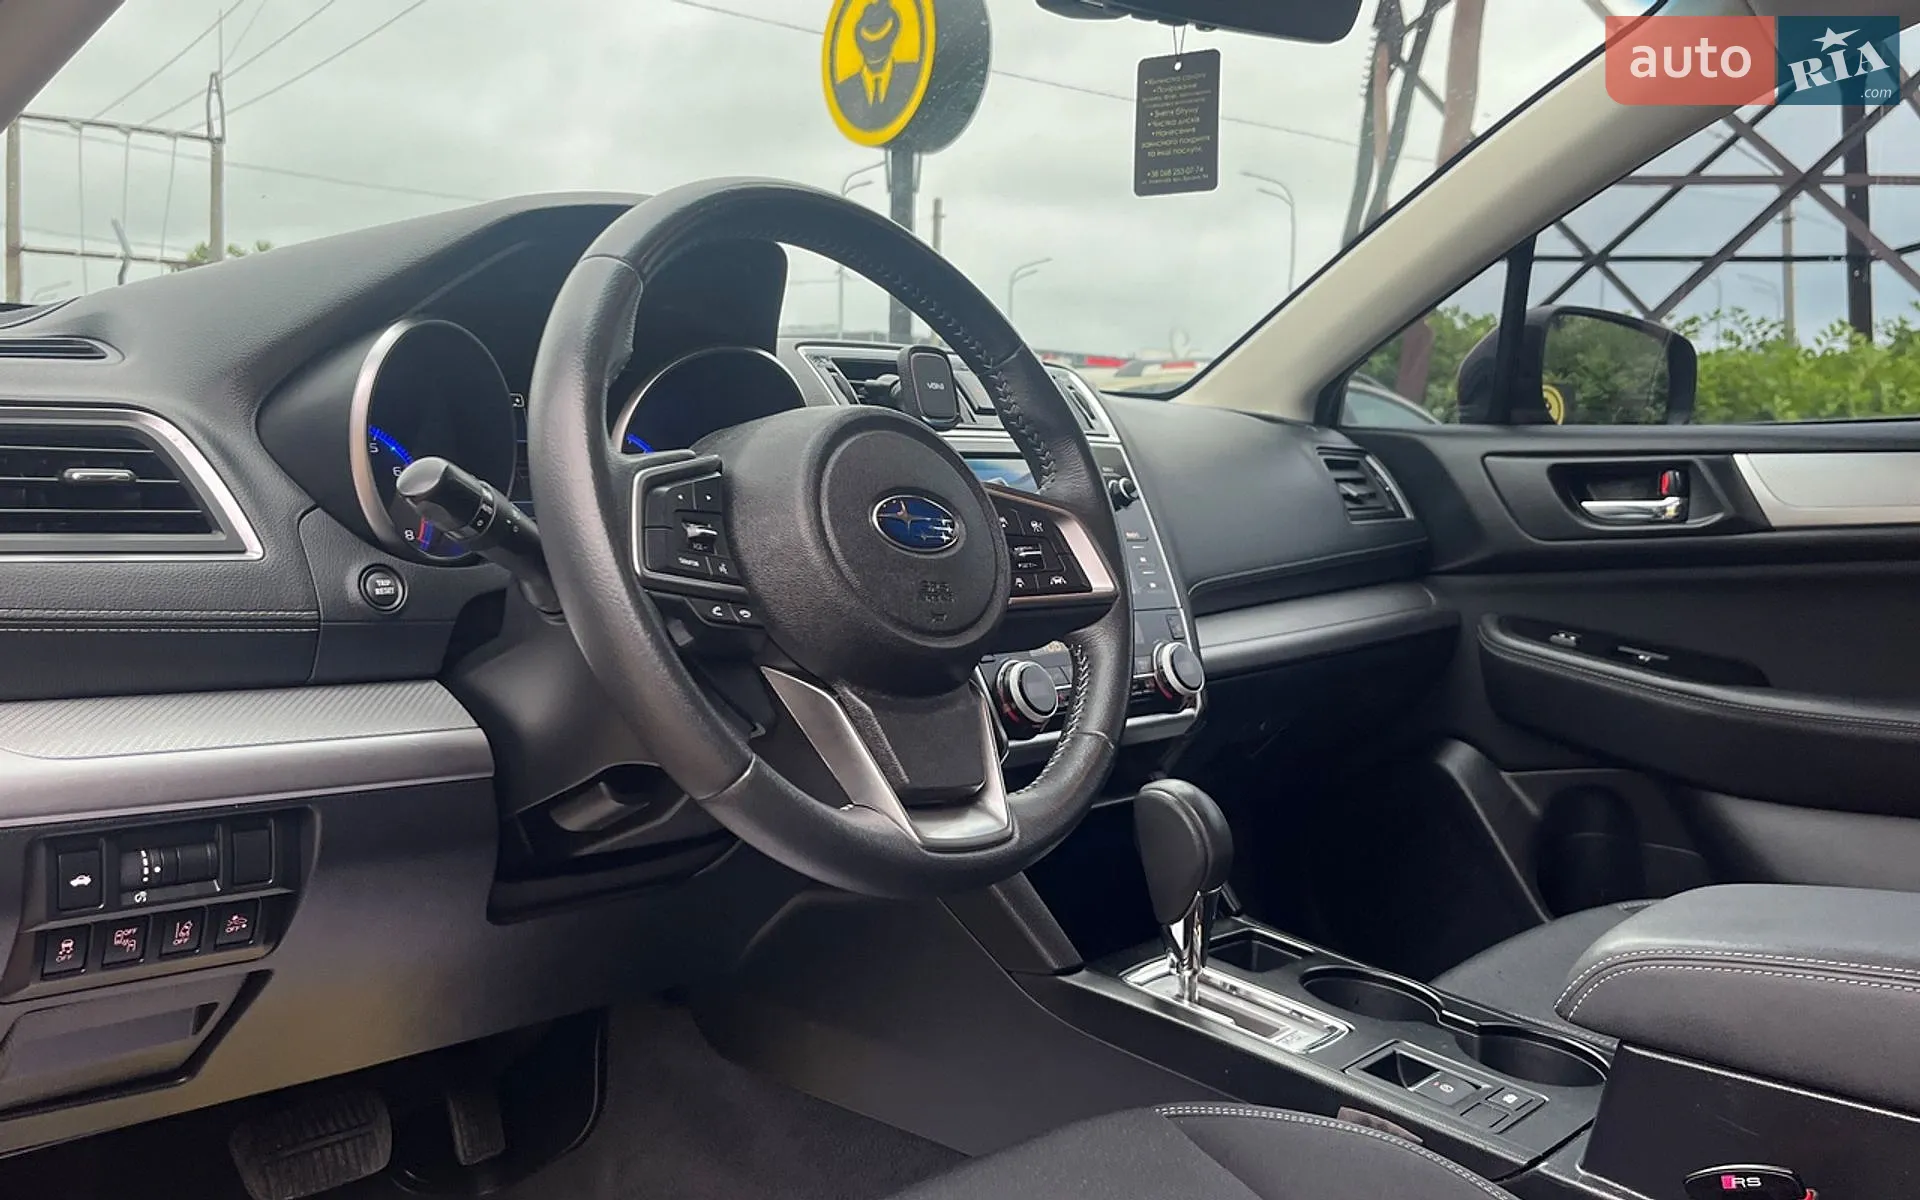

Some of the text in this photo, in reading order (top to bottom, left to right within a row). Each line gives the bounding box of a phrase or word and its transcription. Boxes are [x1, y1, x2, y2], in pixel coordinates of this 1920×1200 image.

[369, 441, 379, 453] 5
[404, 529, 415, 541] 8
[1733, 1177, 1762, 1188] RS
